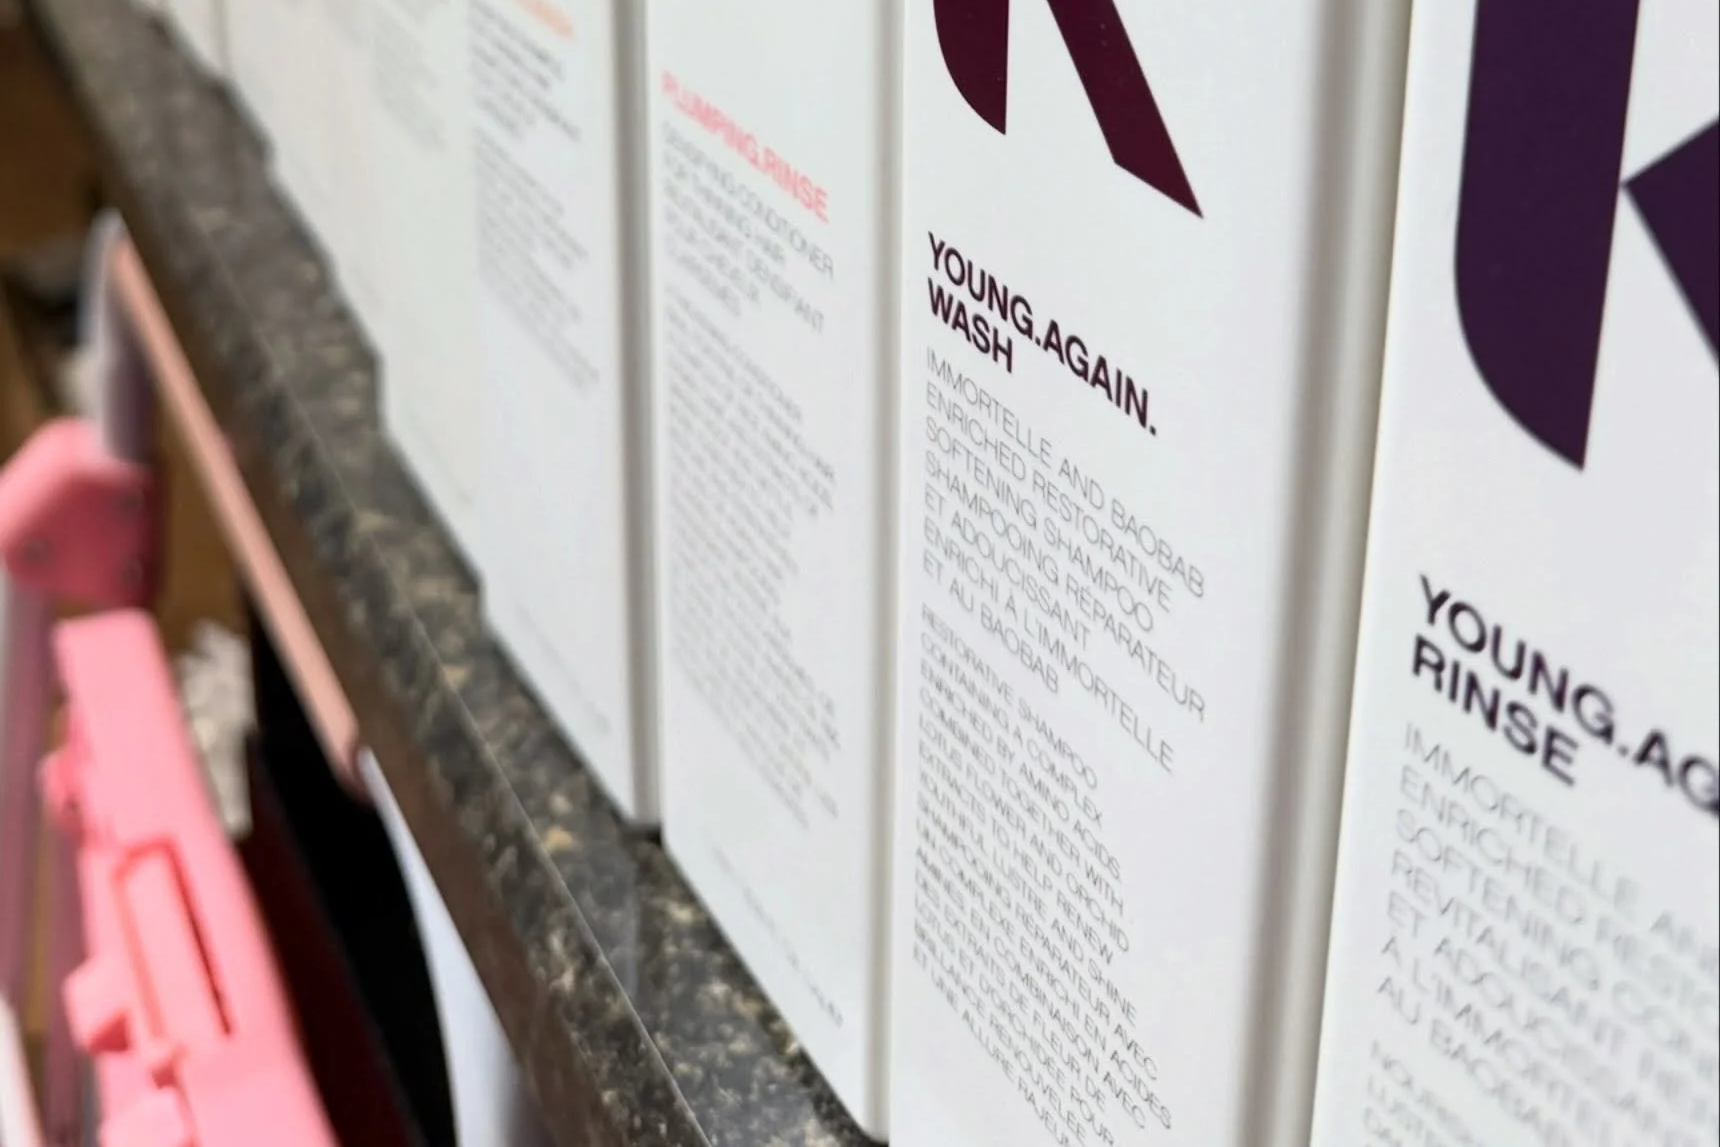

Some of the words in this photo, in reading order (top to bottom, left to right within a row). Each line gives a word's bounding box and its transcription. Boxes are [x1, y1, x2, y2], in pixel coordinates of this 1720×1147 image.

[928, 277, 1014, 373] WASH
[928, 231, 1158, 436] YOUNG.AGAIN.
[926, 379, 1025, 485] ENRICHED
[1032, 467, 1172, 615] RESTORATIVE
[926, 413, 1036, 531] SOFTENING
[1043, 513, 1153, 637] SHAMPOO
[927, 345, 1051, 469] IMMORTELLE
[1058, 454, 1104, 515] AND
[1111, 496, 1204, 602] BAOBAB
[923, 546, 941, 586] ET
[949, 575, 973, 616] AU
[980, 601, 1058, 697] BAOBAB
[924, 480, 945, 521] ET
[951, 508, 1090, 656] ADOUCISSANT
[925, 446, 1058, 587] SHAMPOOING
[1066, 571, 1204, 725] RÉPARATEUR
[922, 601, 1013, 708] RESTORATIVE
[1018, 694, 1097, 794] SHAMPOO
[924, 513, 998, 605] ENRICHI
[1024, 606, 1173, 776] L'IMMORTELLE
[1413, 634, 1580, 787] RINSE
[996, 731, 1015, 771] BY
[1018, 758, 1069, 827] AMINO
[999, 764, 1080, 870] TOGETHER
[1084, 854, 1123, 919] WITH
[1012, 721, 1023, 748] A
[1026, 734, 1102, 831] COMPLEX
[966, 759, 1025, 840] FLOWER
[1029, 829, 1062, 881] AND
[1065, 868, 1129, 958] ORCHID
[990, 814, 1009, 853] TO
[1013, 839, 1053, 901] HELP
[1056, 886, 1113, 969] RENEW
[1388, 890, 1425, 940] ET
[1050, 913, 1084, 966] AND
[1087, 954, 1136, 1030] SHINE
[1377, 975, 1423, 1026] AU
[1032, 1006, 1080, 1083] FLEUR
[1085, 1070, 1105, 1115] DE
[1070, 1083, 1114, 1147] POUR
[1084, 1010, 1106, 1053] EN
[1110, 1044, 1172, 1135] ACIDES
[1103, 1066, 1146, 1134] AVEC
[1113, 1018, 1157, 1086] AVEC
